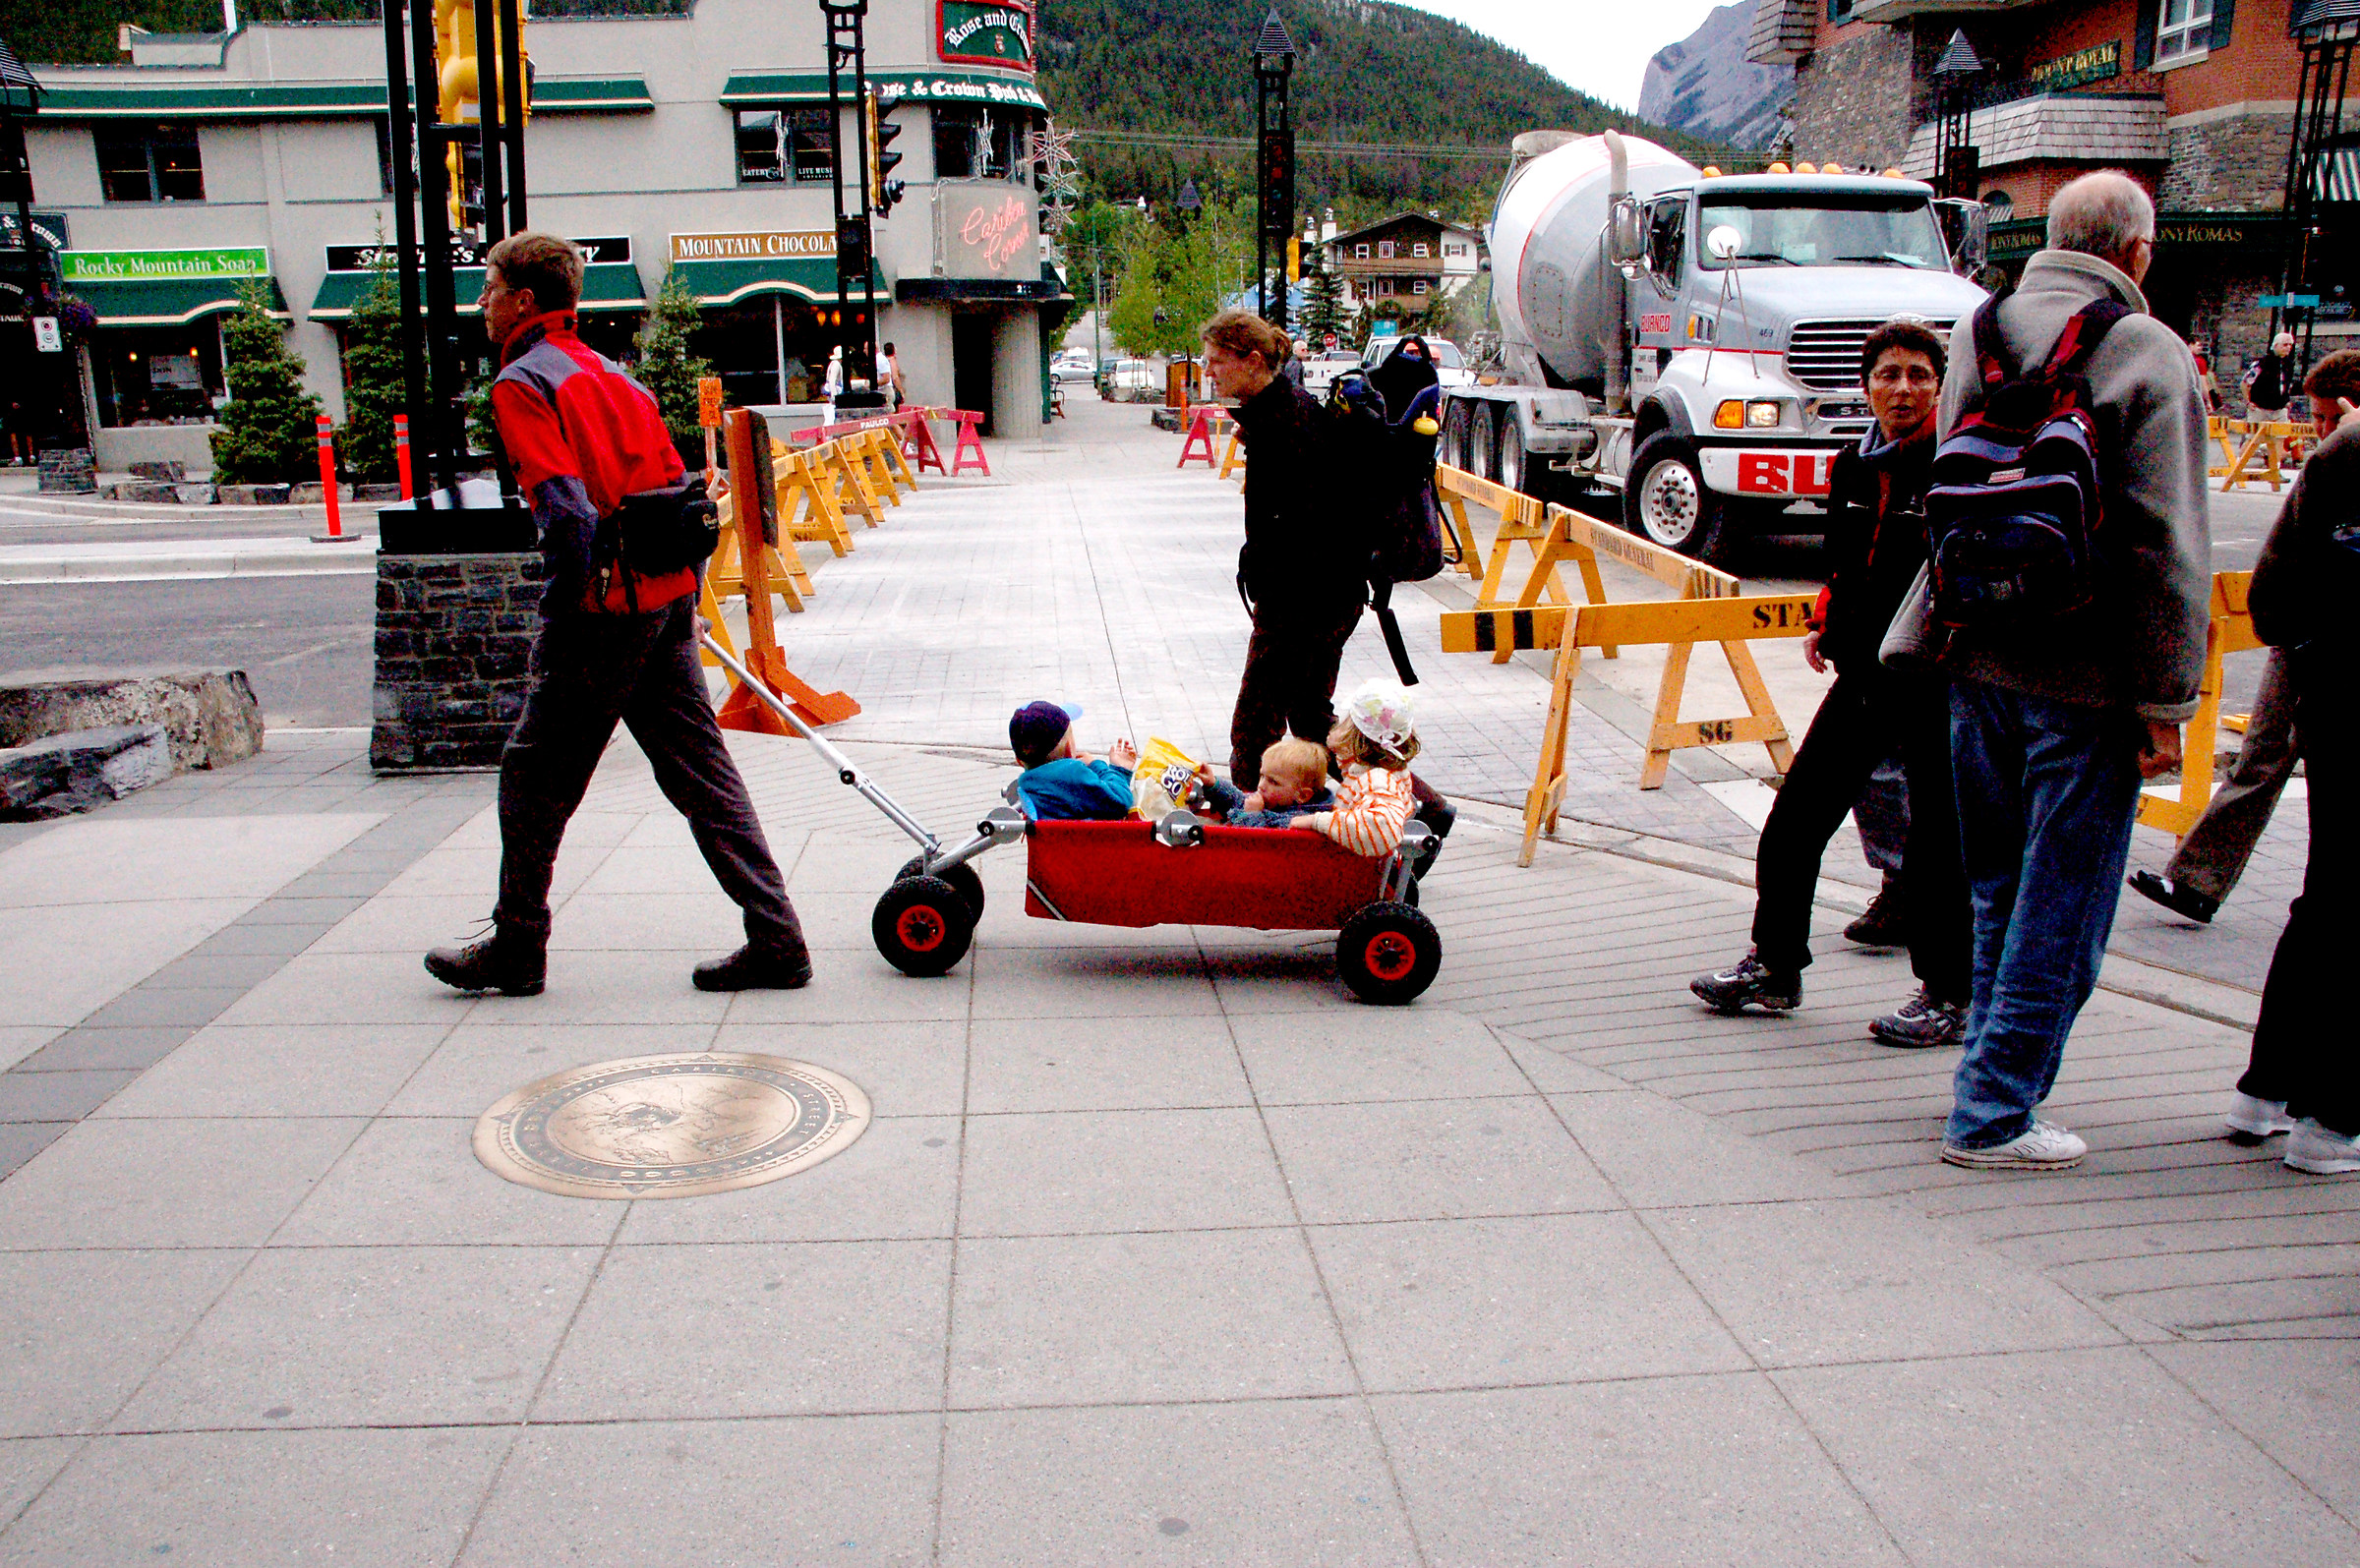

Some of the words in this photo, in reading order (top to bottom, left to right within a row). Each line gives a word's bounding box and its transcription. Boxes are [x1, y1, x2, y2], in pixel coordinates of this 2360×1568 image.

[944, 17, 982, 48] Rose
[984, 9, 1007, 28] and
[2076, 44, 2117, 71] ROYAL
[912, 80, 927, 96] &
[930, 82, 986, 98] Crown
[678, 237, 761, 258] MOUNTAIN
[75, 257, 125, 276] Rocky
[131, 257, 211, 273] Mountain
[217, 255, 257, 275] Soap
[1640, 315, 1671, 332] BURNCO
